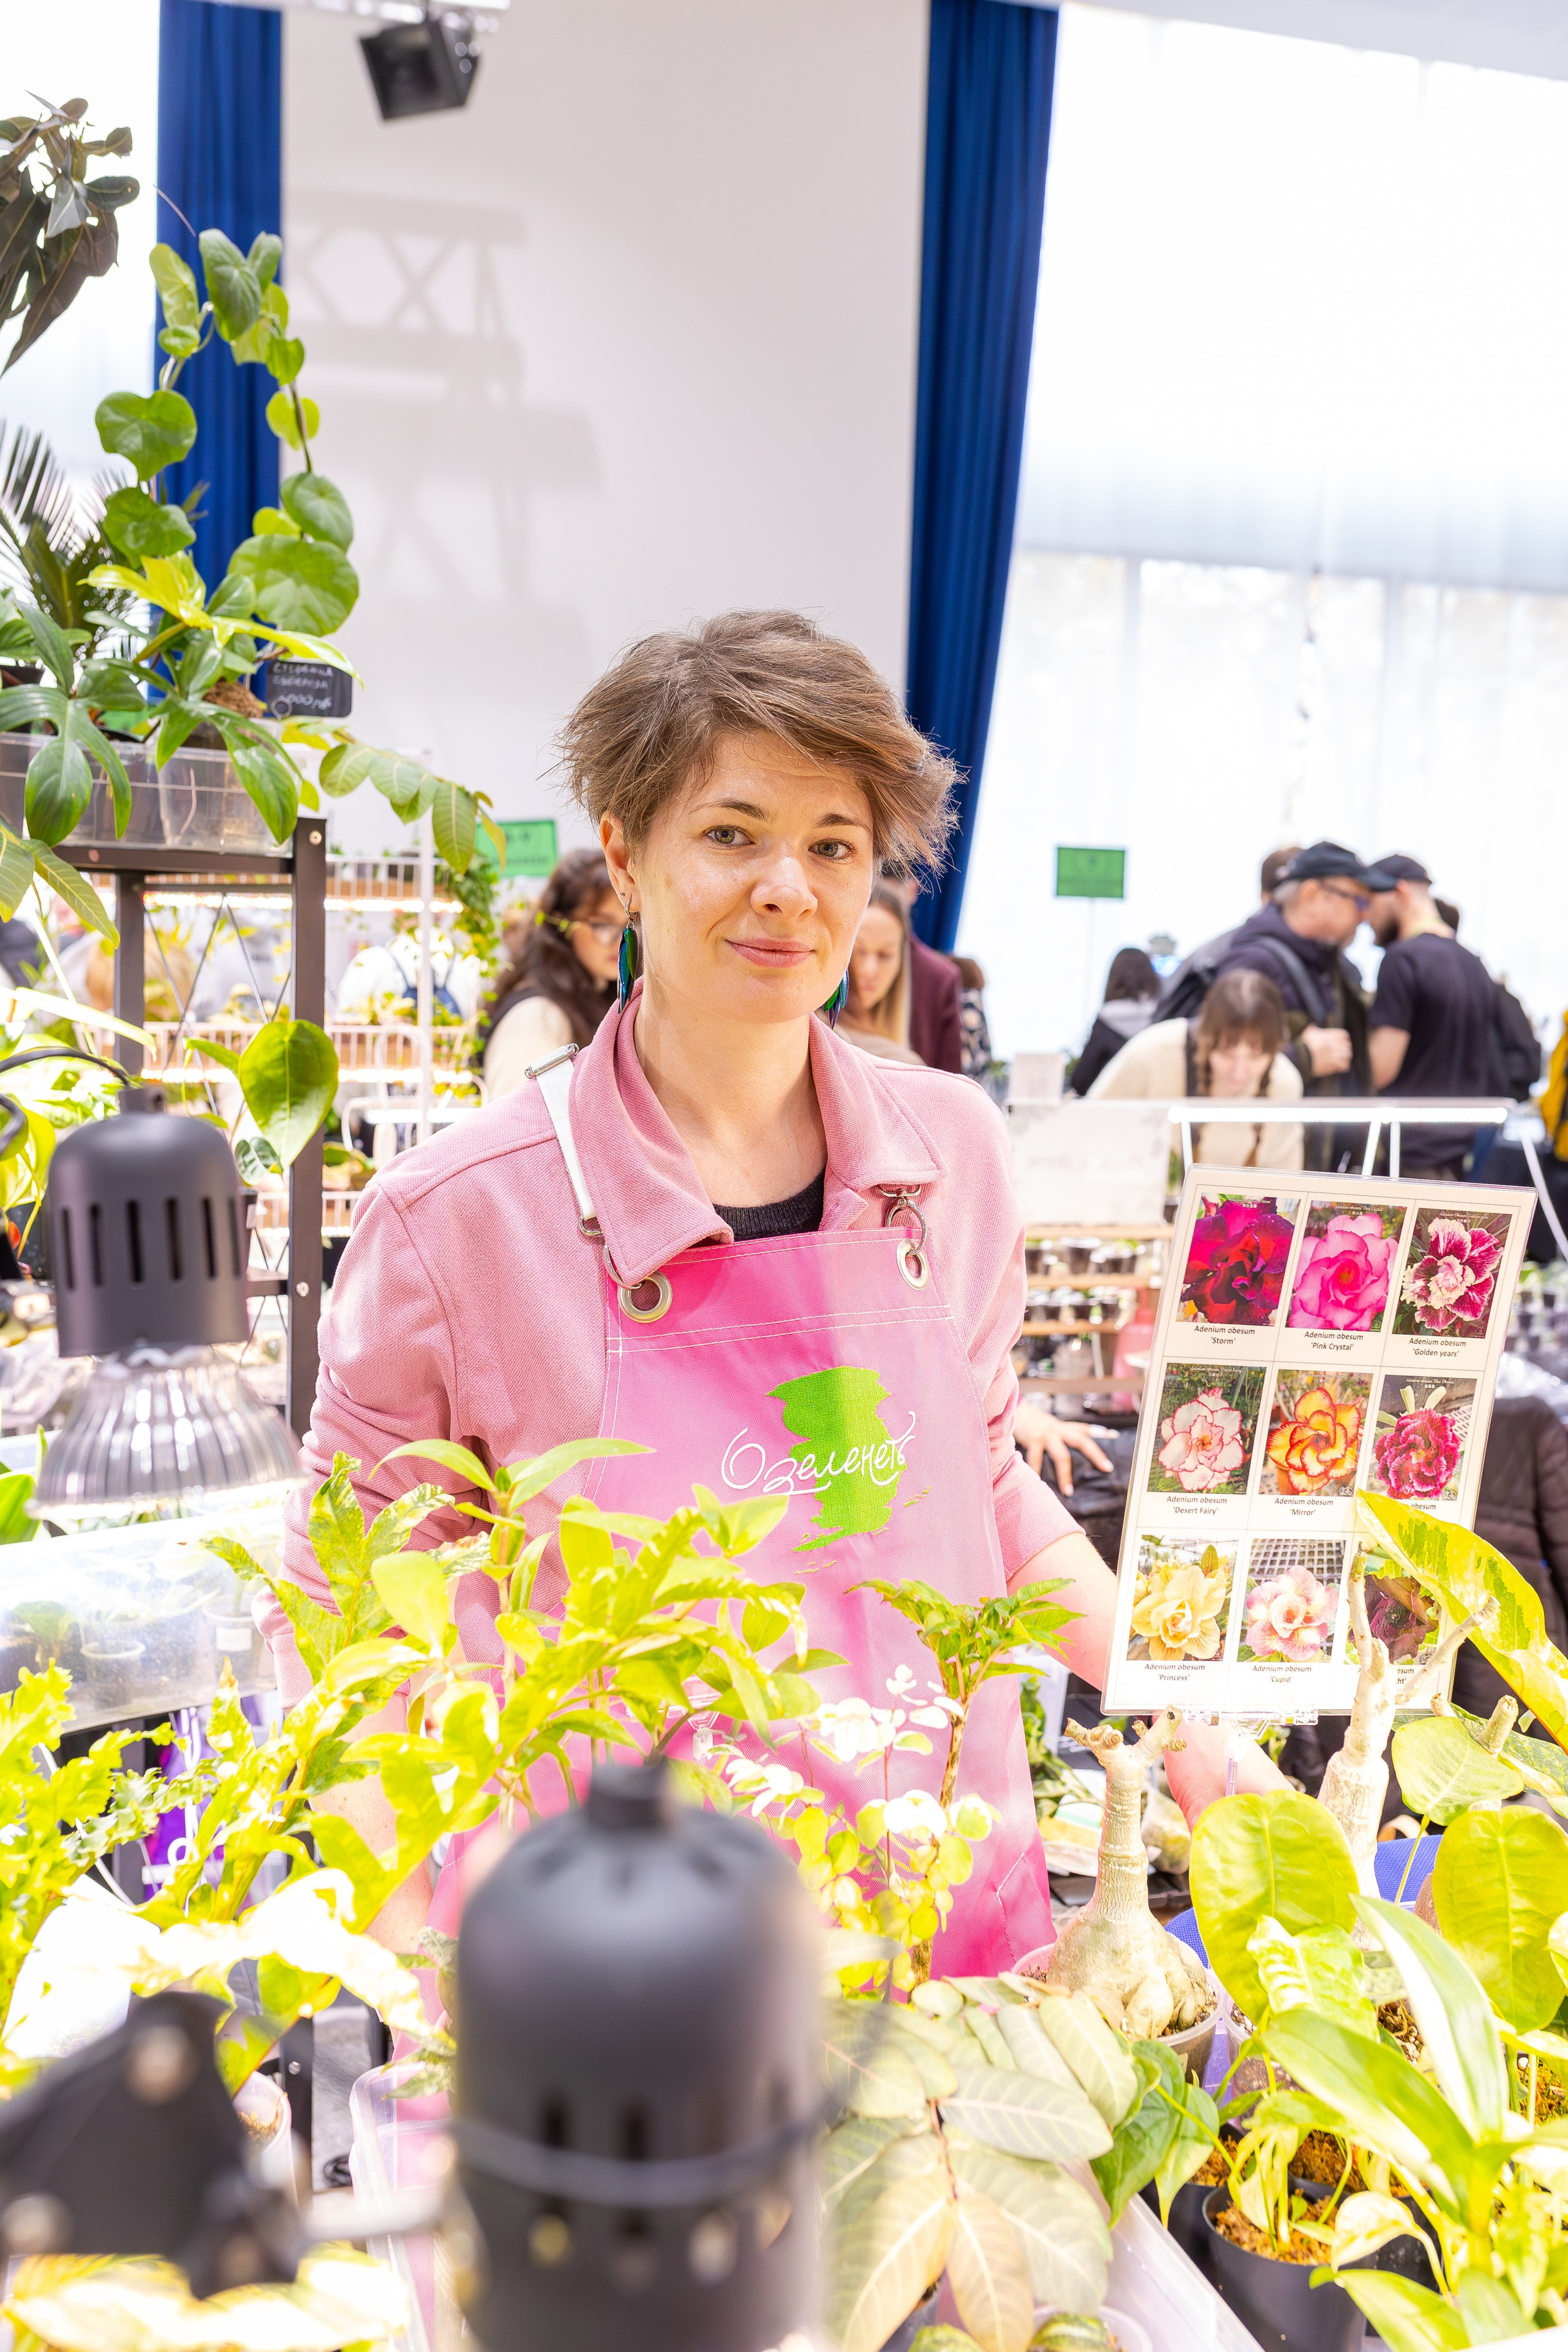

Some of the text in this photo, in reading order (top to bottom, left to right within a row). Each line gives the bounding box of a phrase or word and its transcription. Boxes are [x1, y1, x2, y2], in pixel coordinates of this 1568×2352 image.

[1329, 1343, 1354, 1351] Crystal'
[1199, 1507, 1218, 1516] Fairy'
[1270, 1675, 1293, 1684] 'Cupid'
